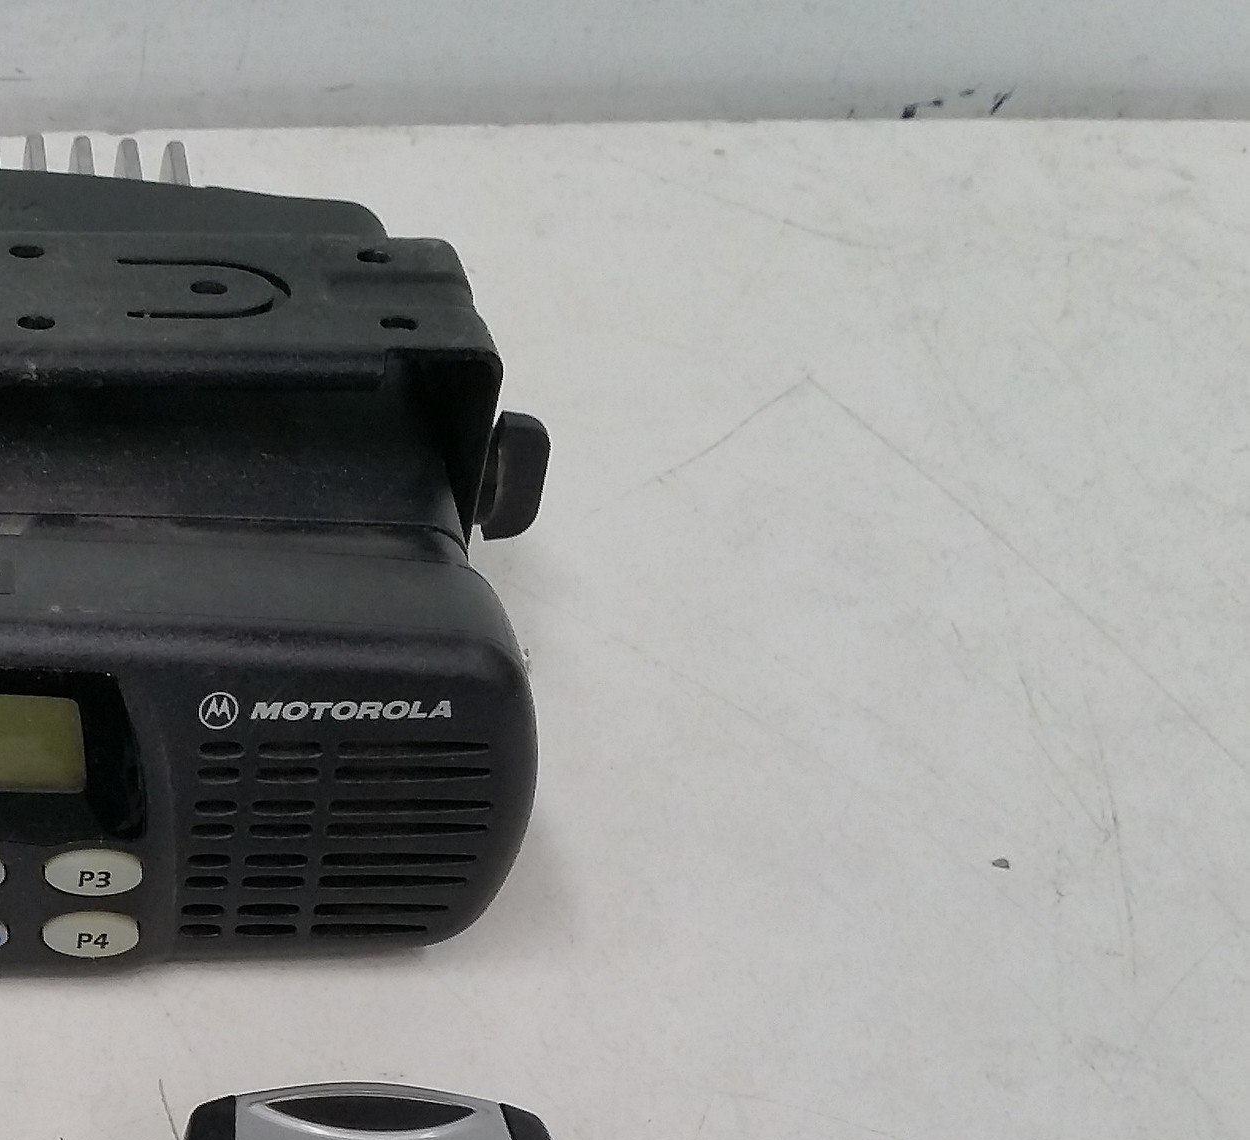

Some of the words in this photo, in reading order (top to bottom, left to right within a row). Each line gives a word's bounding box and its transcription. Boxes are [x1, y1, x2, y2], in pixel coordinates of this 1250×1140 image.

[249, 700, 452, 721] MOTOROLA
[77, 870, 112, 889] P3
[76, 932, 110, 950] P4
